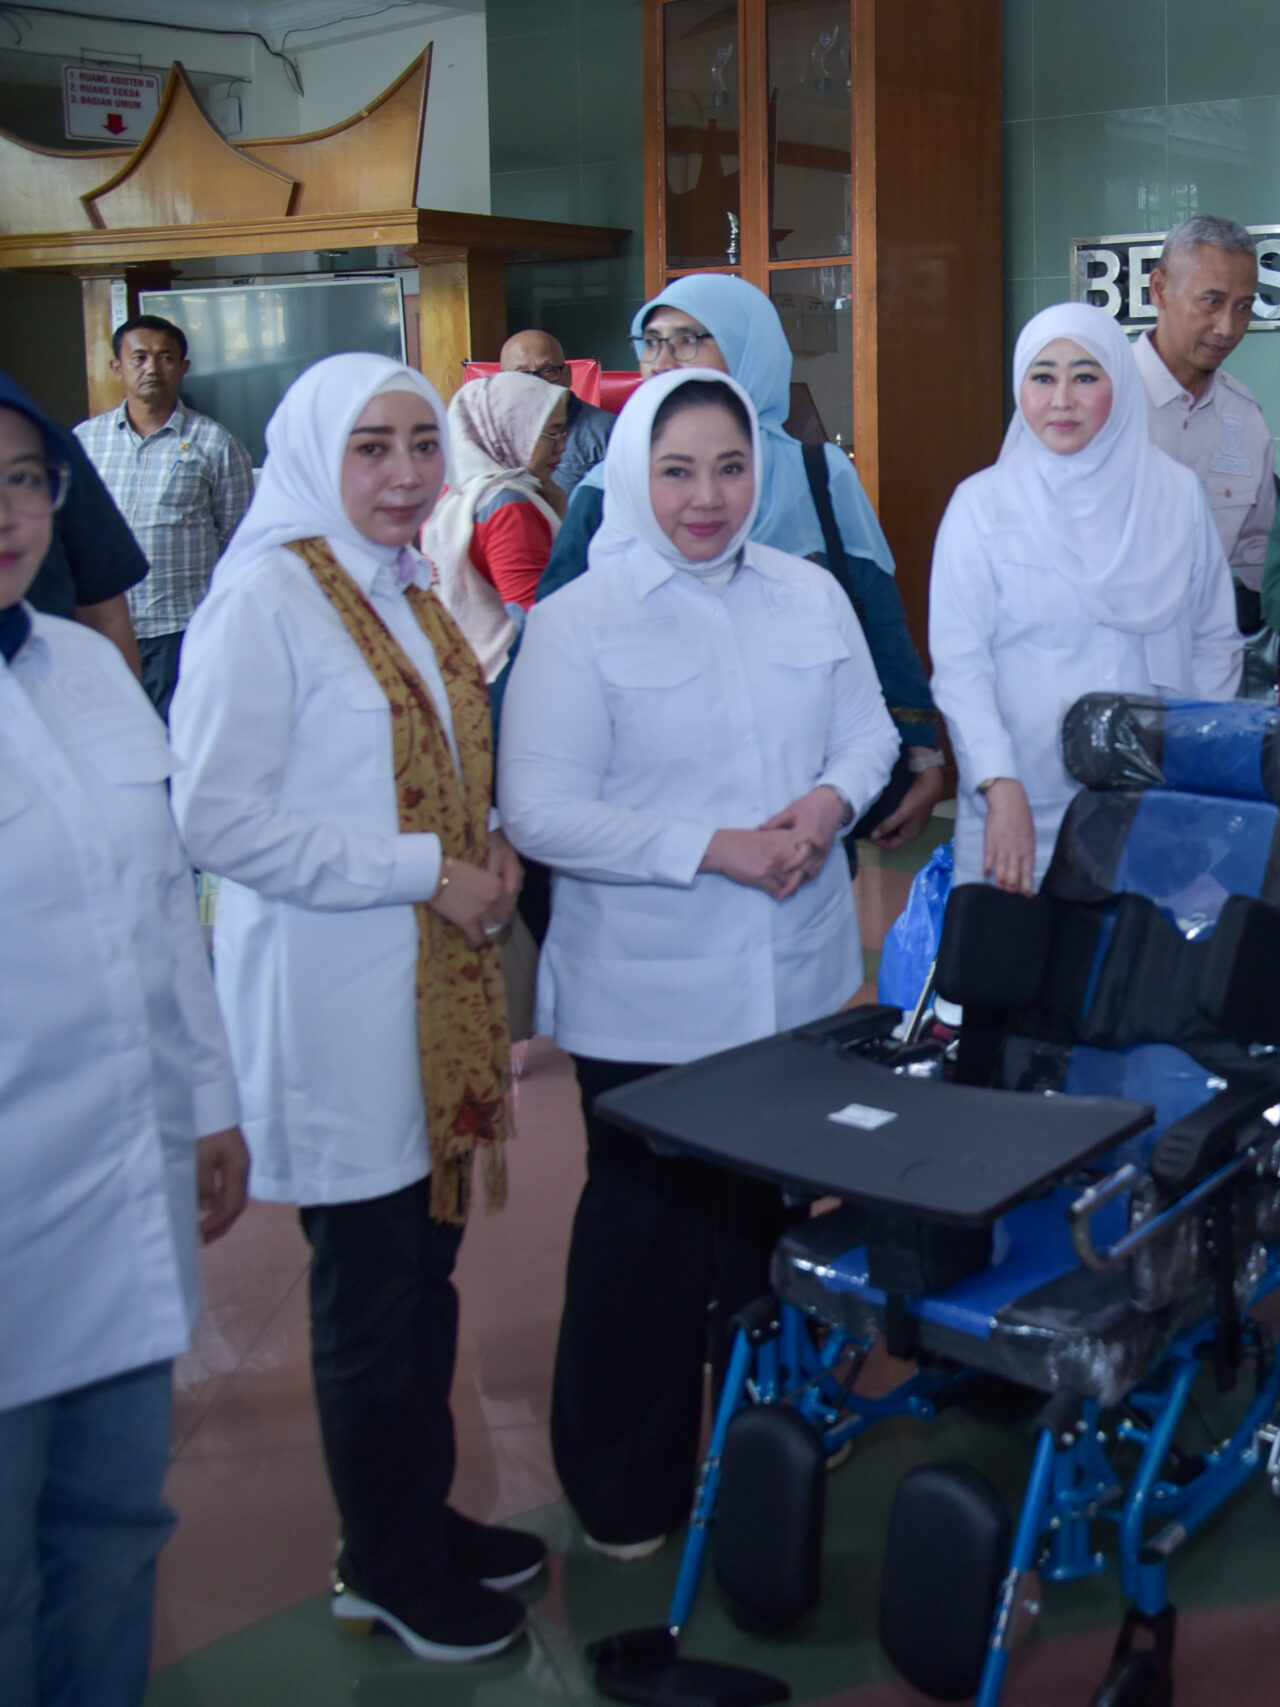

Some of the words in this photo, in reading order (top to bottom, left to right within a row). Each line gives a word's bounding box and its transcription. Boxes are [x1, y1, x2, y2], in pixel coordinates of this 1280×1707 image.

[80, 73, 108, 83] RUANG
[80, 84, 110, 95] RUANG
[81, 96, 112, 106] BAGIAN
[115, 99, 141, 109] UMUM
